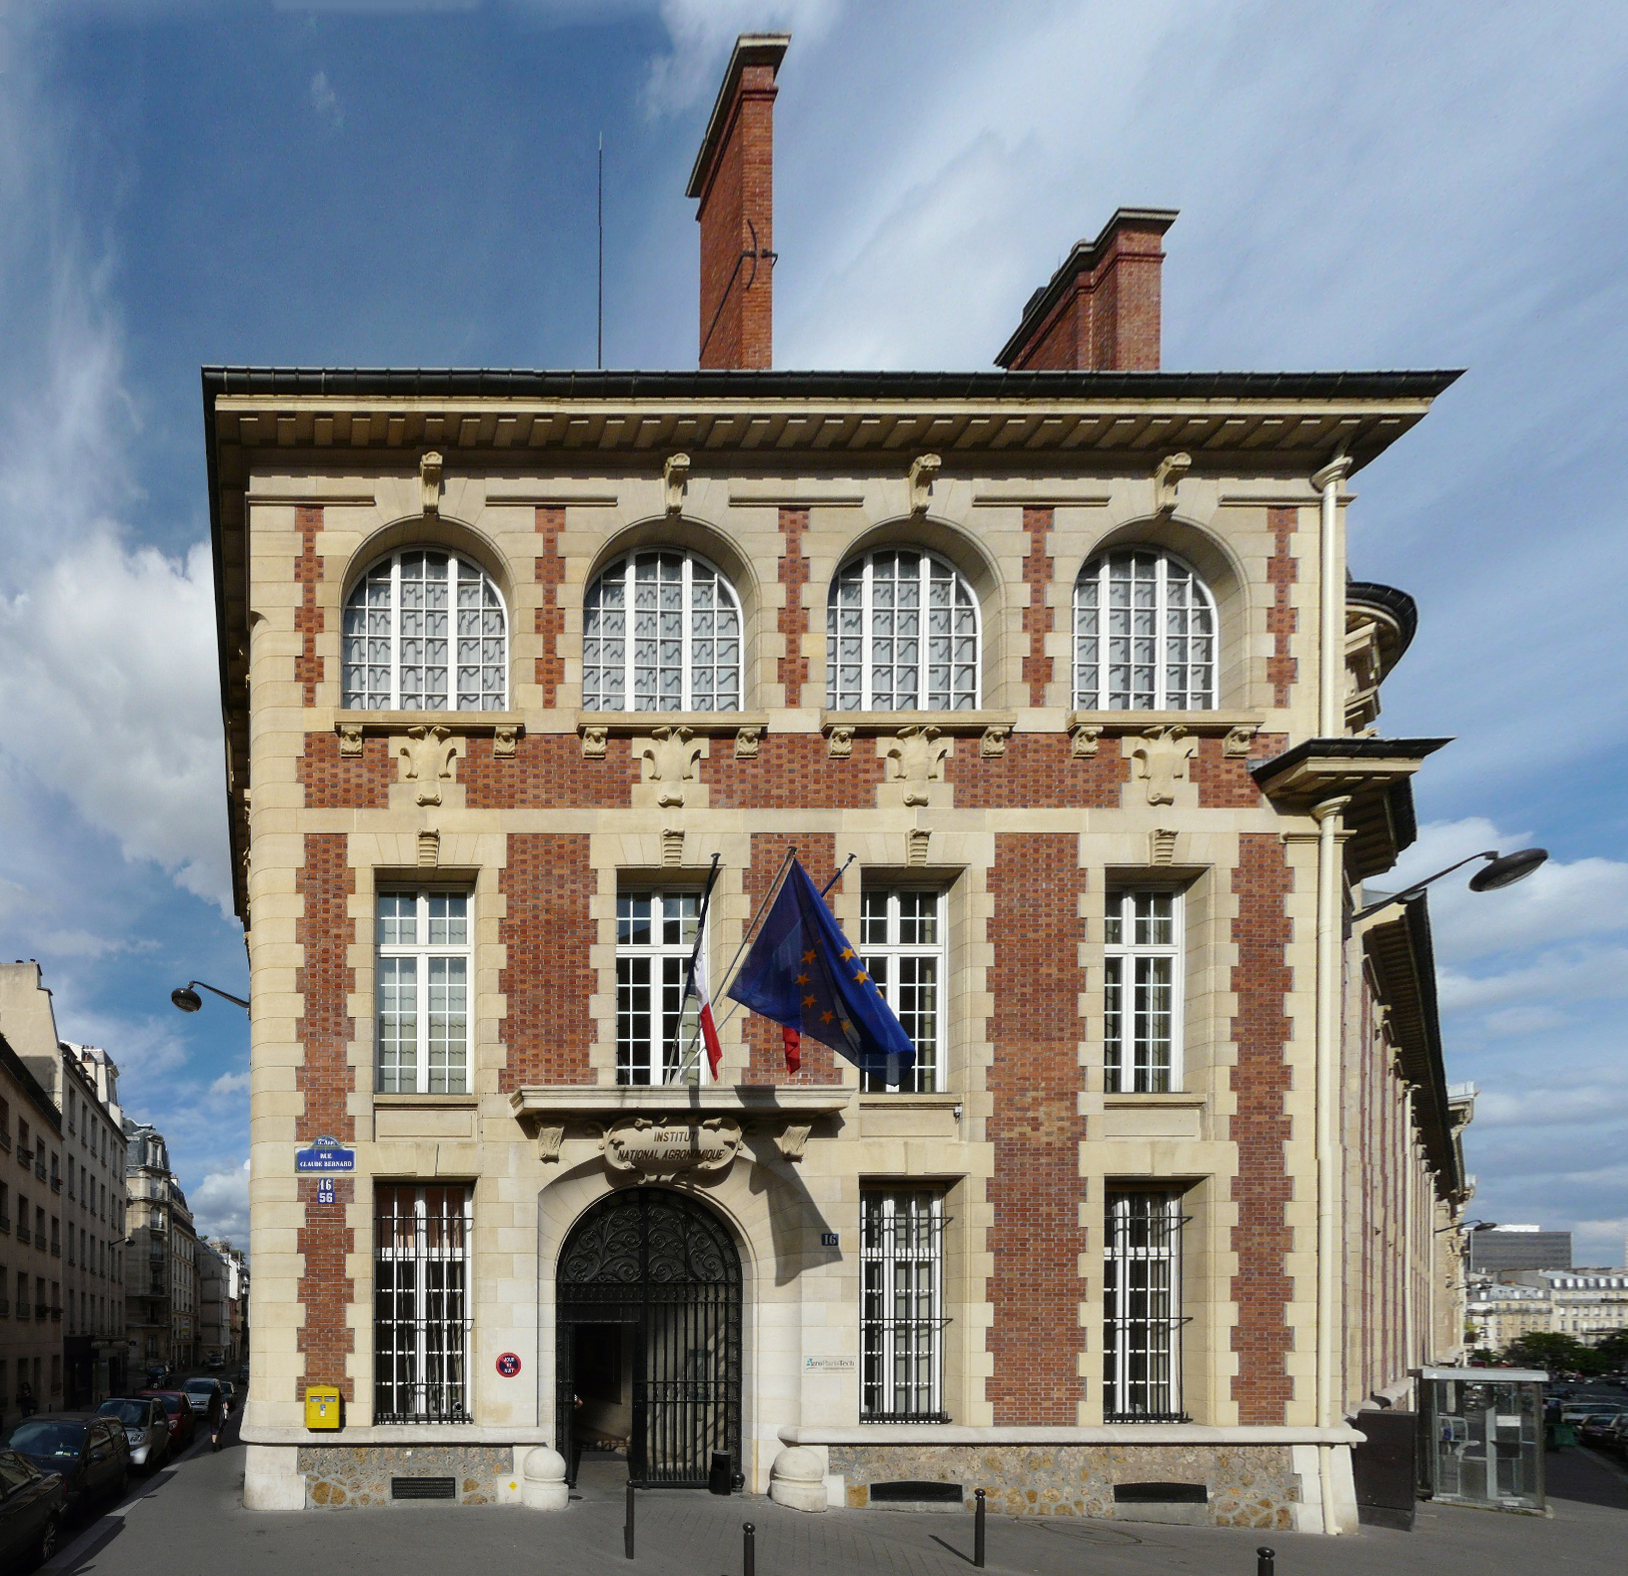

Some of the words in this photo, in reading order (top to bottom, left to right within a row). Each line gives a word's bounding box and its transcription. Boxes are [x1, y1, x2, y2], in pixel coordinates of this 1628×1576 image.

[653, 1131, 697, 1142] INSTITUT
[617, 1149, 659, 1161] NATIONAL
[662, 1149, 725, 1161] AGRONOMIQUE
[320, 1179, 332, 1191] 16
[319, 1192, 333, 1203] 56
[824, 1235, 837, 1246] 16
